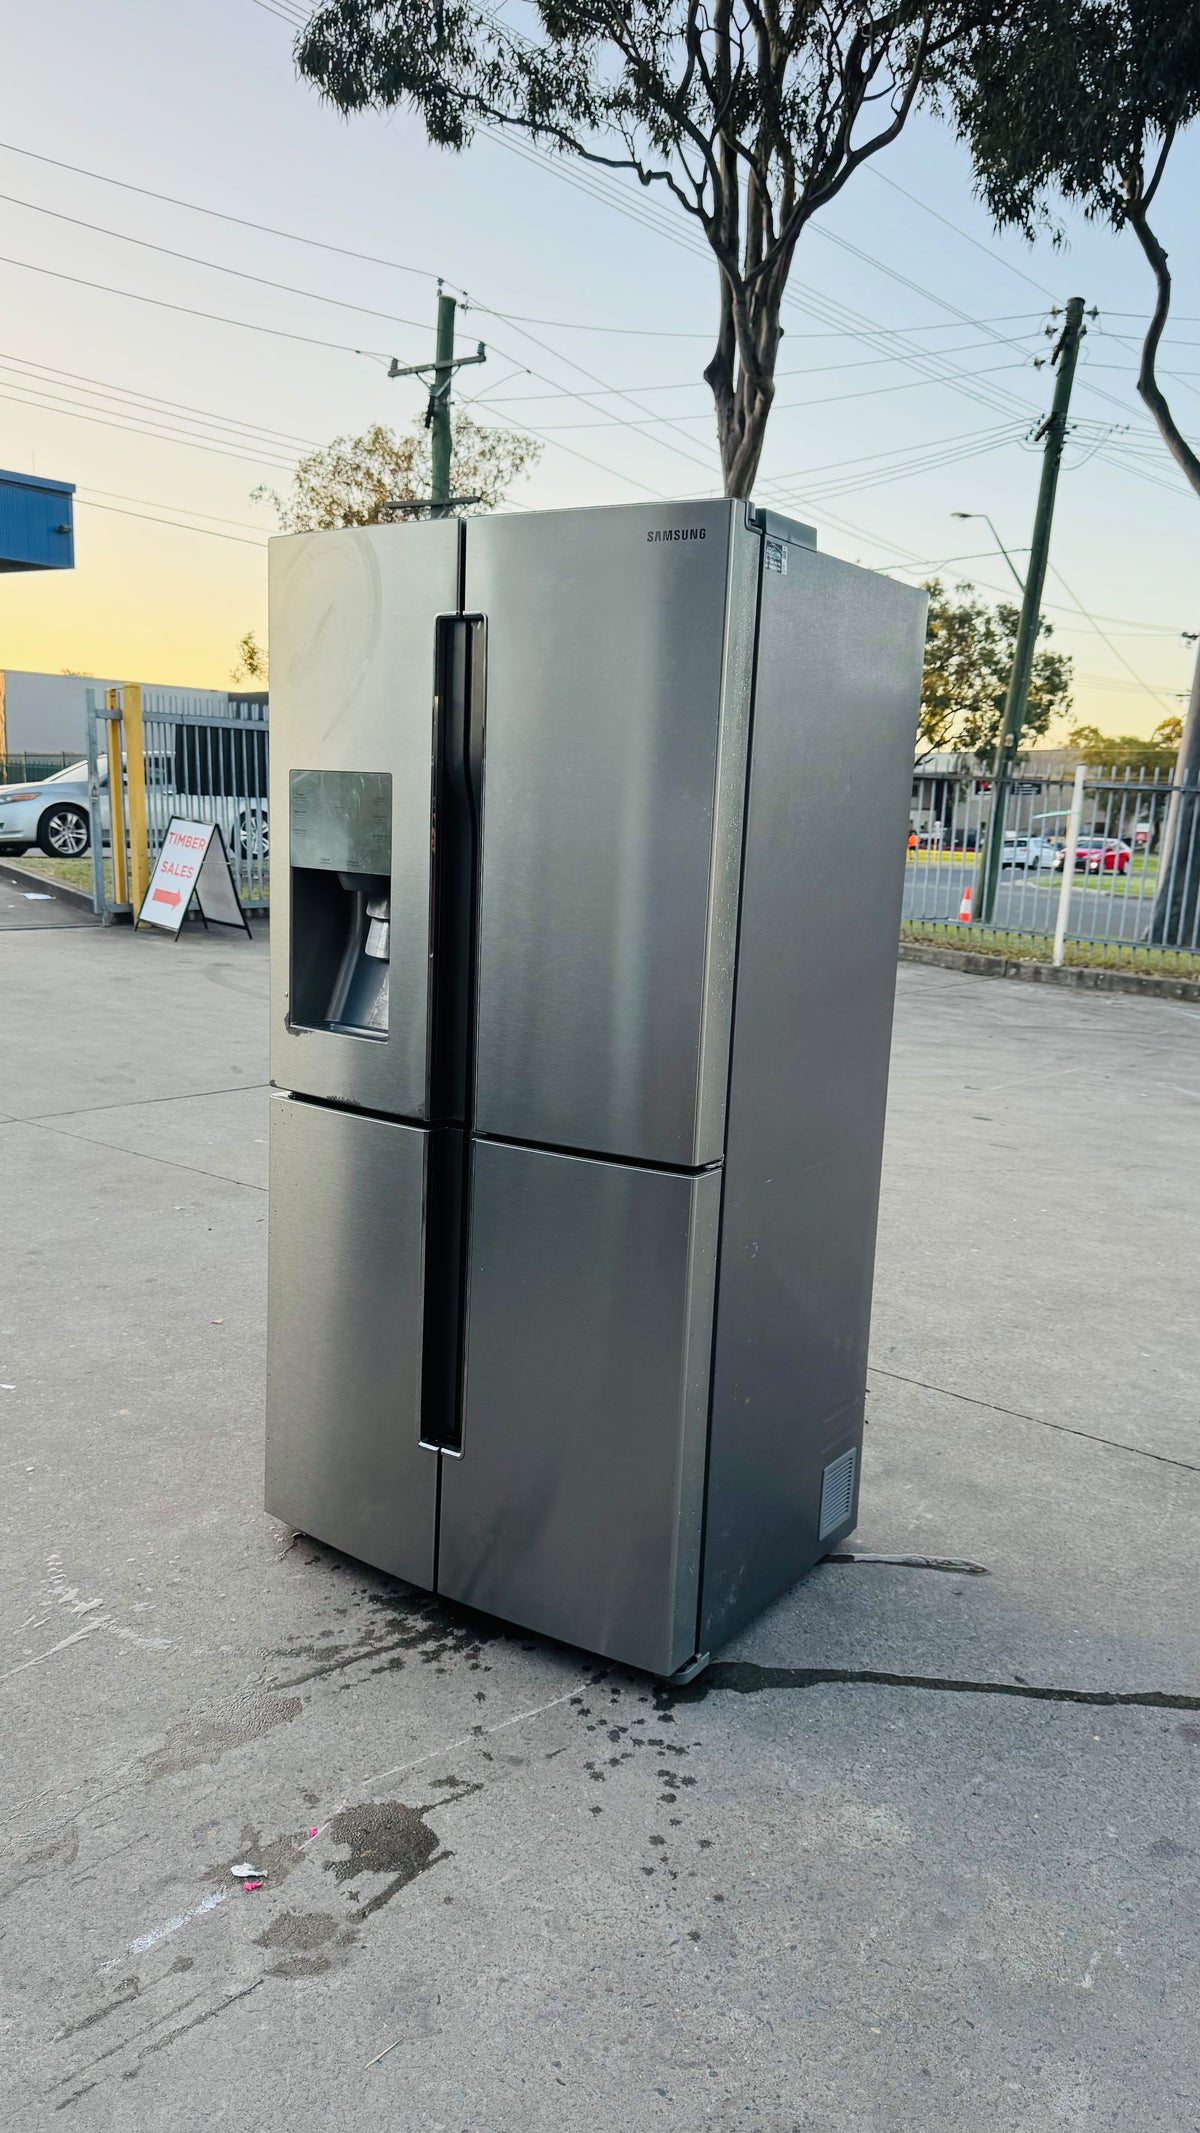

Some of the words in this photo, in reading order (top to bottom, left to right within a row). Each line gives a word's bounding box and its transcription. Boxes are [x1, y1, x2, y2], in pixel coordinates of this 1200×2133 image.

[646, 528, 707, 543] SAMSUNG
[168, 832, 206, 850] TIMBER
[161, 861, 193, 878] SALES
